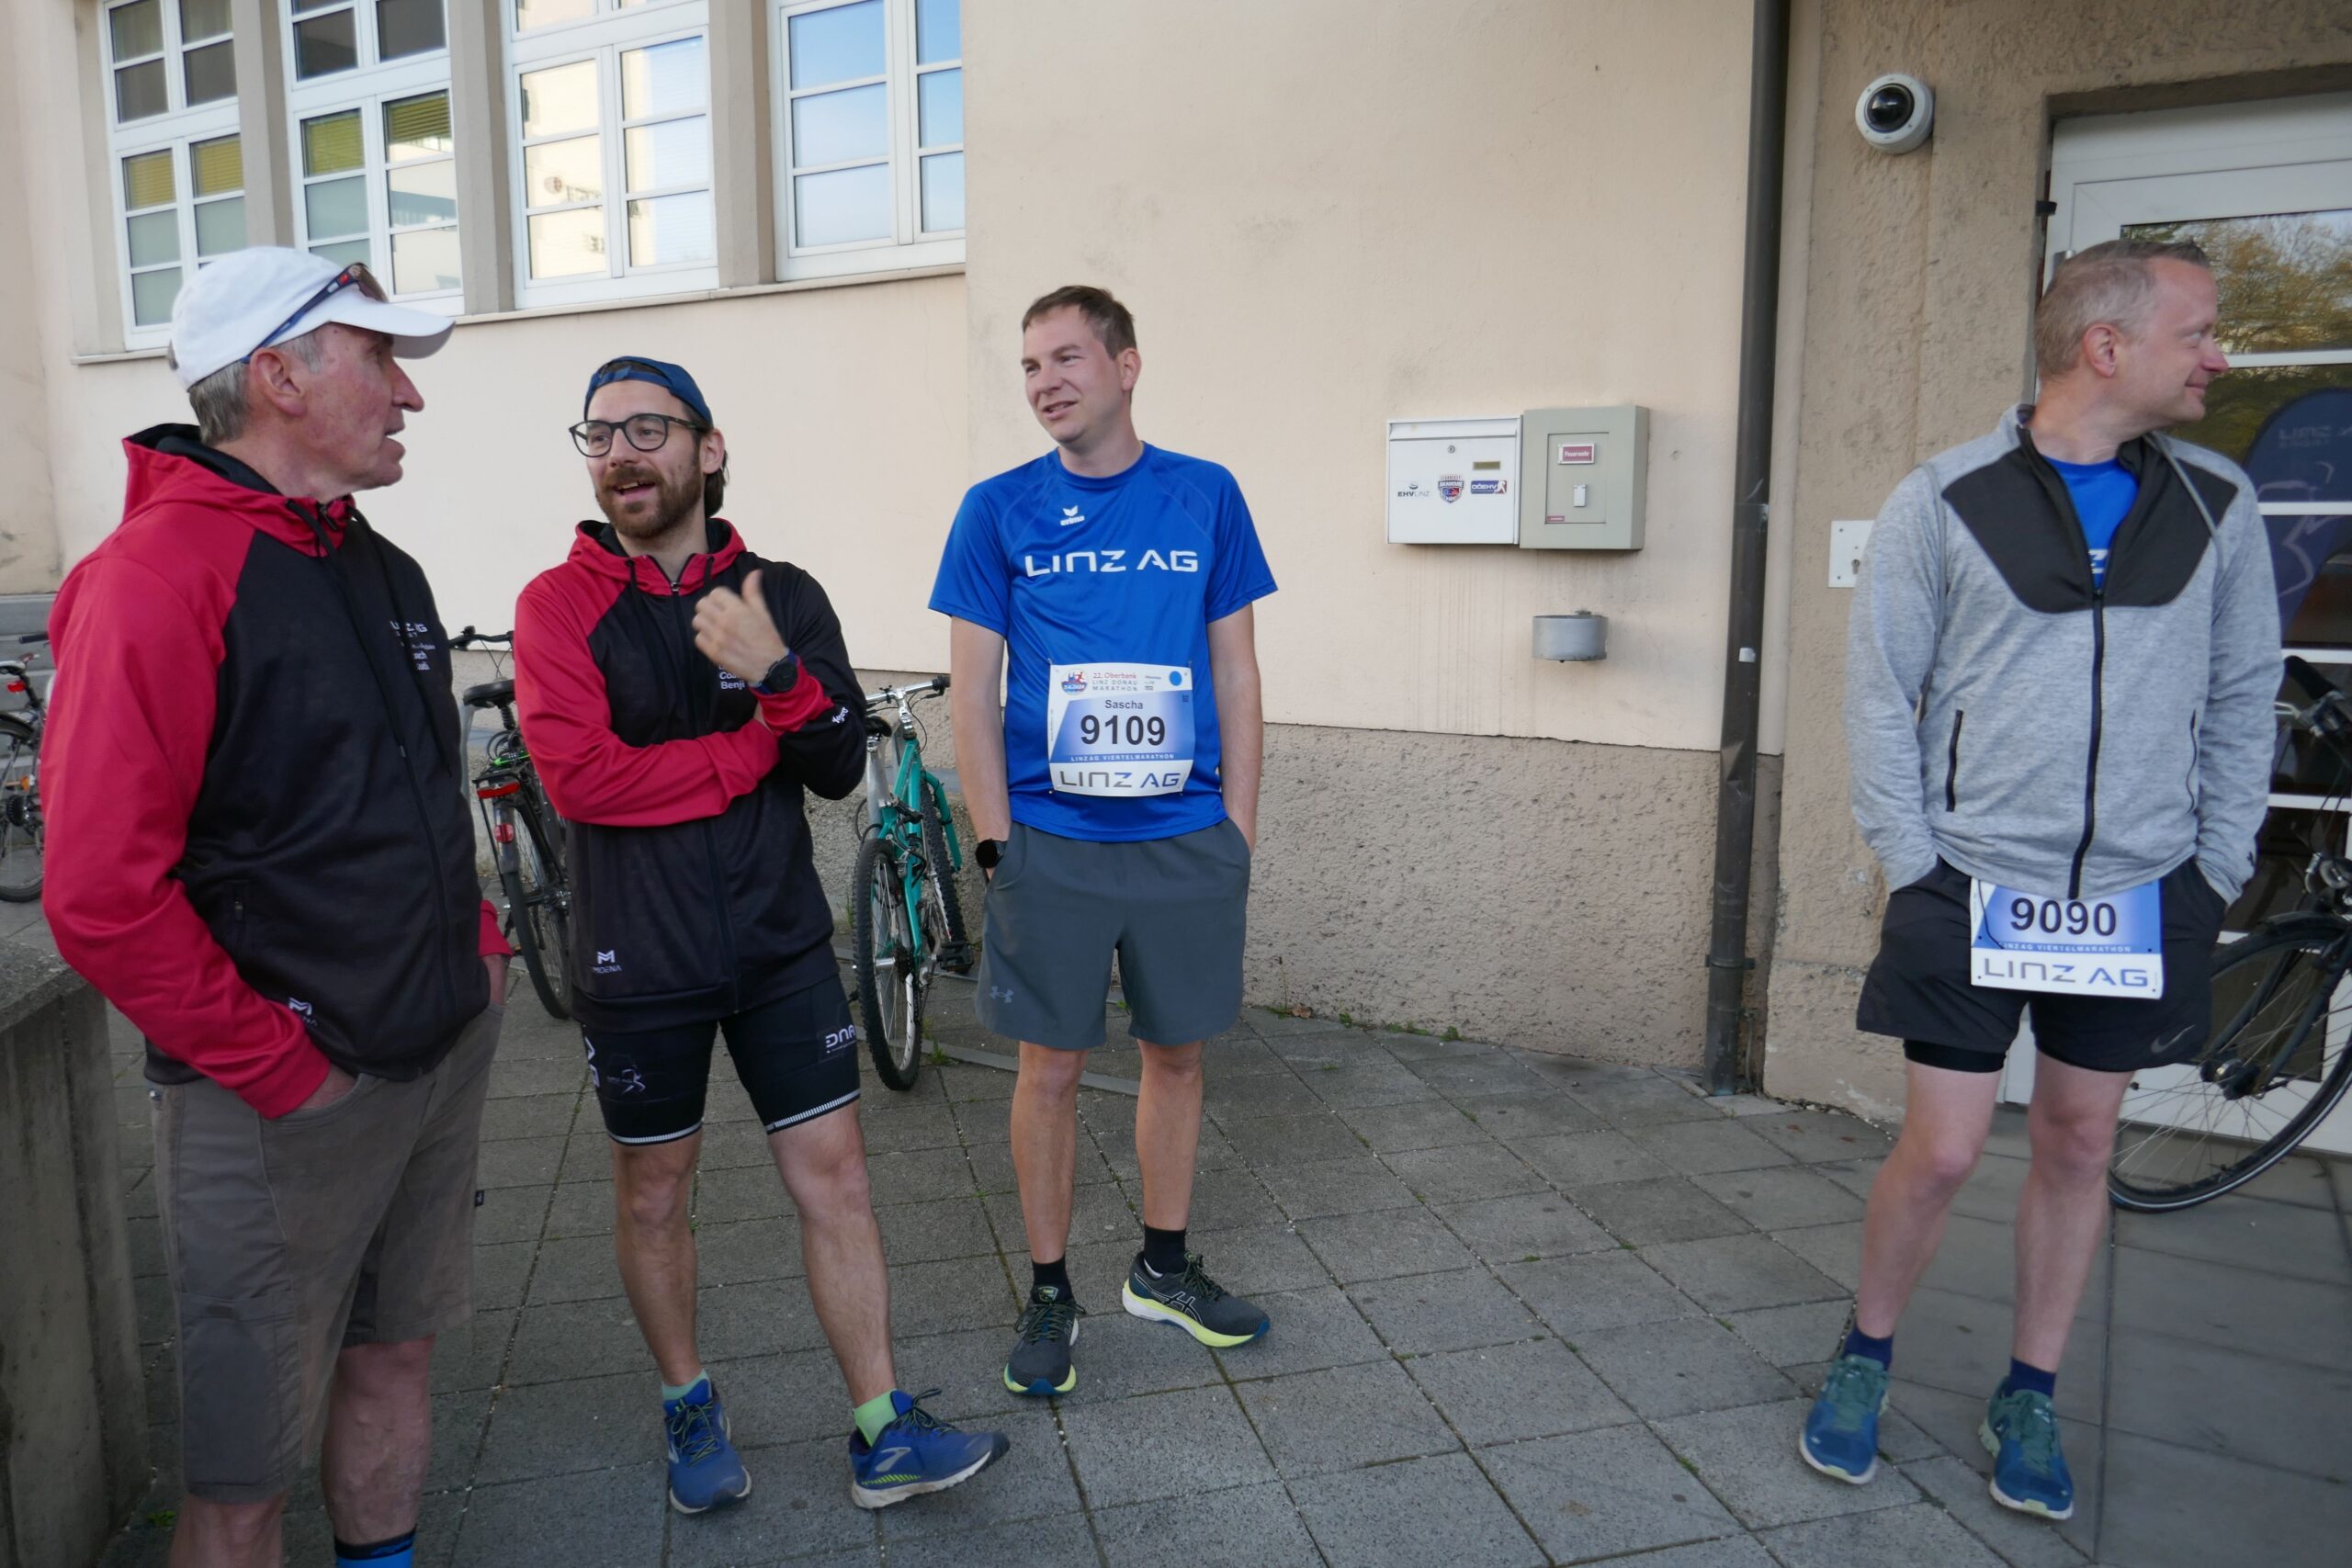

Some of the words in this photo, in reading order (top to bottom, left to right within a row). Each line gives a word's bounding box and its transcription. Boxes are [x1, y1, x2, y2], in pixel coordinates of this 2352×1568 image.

[1024, 549, 1126, 577] LINZ
[1136, 549, 1199, 572] AG
[720, 680, 745, 691] Benji
[1104, 699, 1144, 710] Sascha
[1080, 715, 1166, 746] 9109
[1102, 753, 1175, 761] VIERTELMARATHON
[1059, 771, 1133, 788] LINZ
[1140, 773, 1182, 788] AG
[2010, 897, 2117, 937] 9090
[2037, 942, 2132, 953] VIERTELMARATHON
[1984, 958, 2076, 983] LINZ
[2087, 967, 2148, 987] AG
